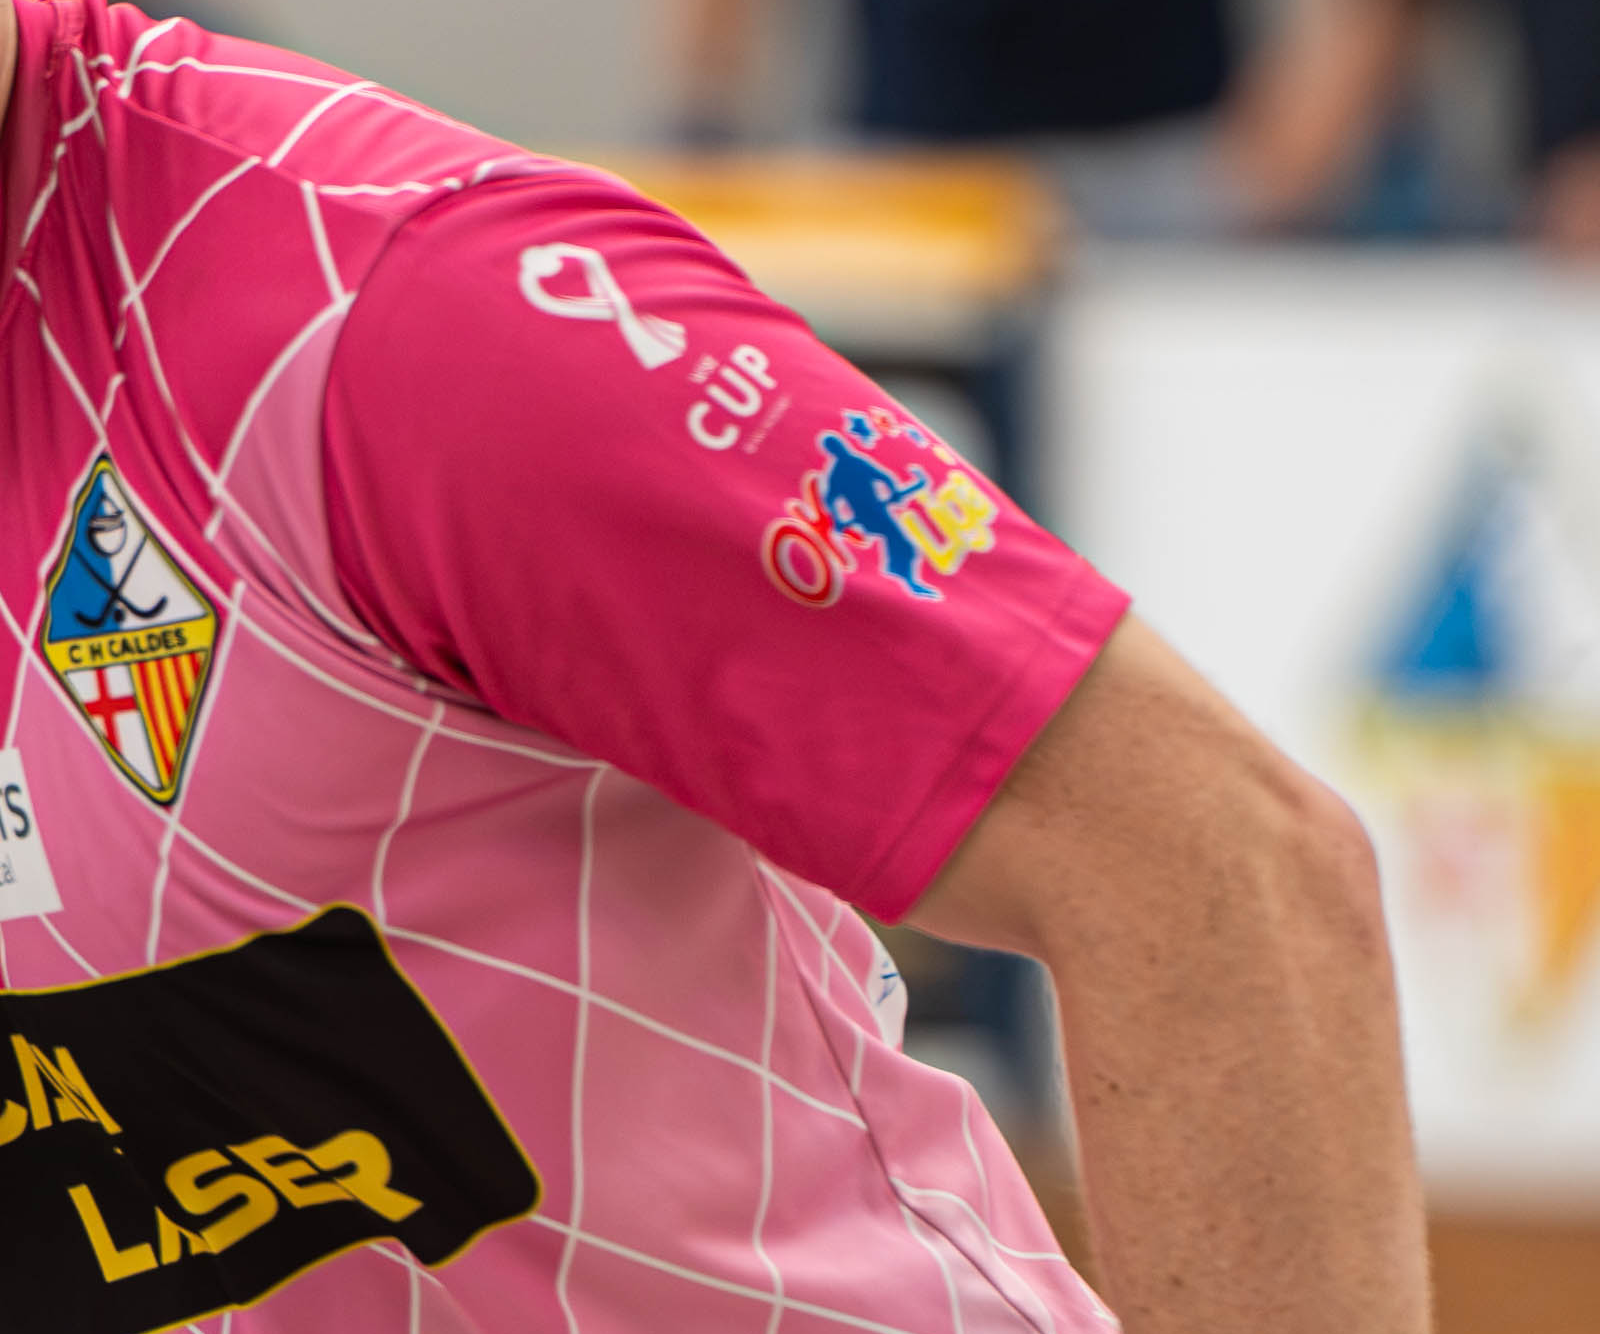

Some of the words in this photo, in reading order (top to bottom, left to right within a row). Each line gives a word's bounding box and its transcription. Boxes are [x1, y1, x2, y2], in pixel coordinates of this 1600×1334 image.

[687, 344, 777, 451] CUP
[761, 470, 857, 609] OK
[68, 644, 82, 663] C
[89, 640, 103, 661] H
[107, 628, 188, 657] CALDES
[68, 1129, 424, 1283] LASER
